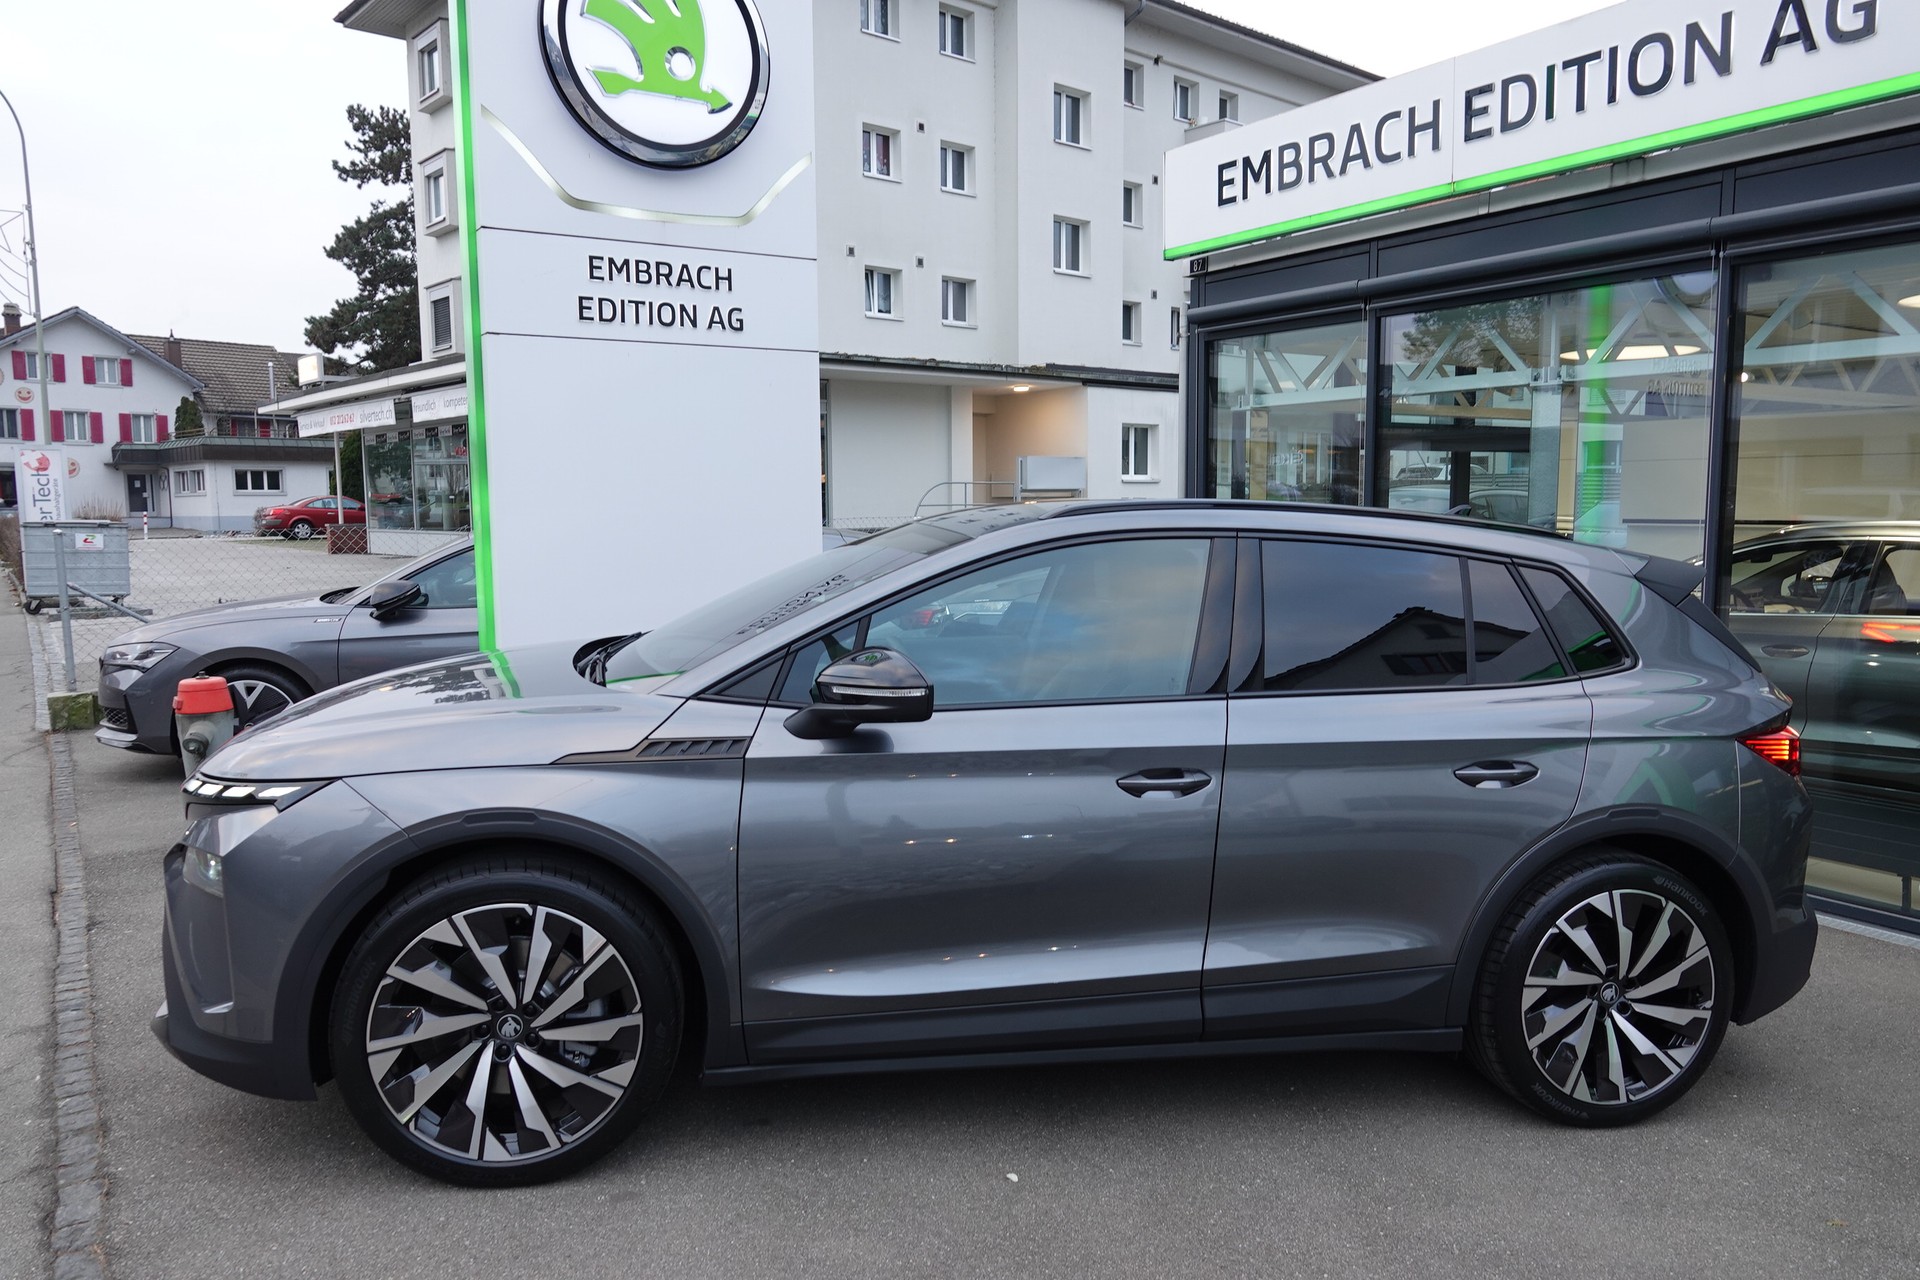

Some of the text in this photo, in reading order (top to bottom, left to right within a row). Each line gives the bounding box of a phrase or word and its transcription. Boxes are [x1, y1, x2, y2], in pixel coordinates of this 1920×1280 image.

[1217, 0, 1879, 208] EMBRACH EDITION AG
[588, 254, 733, 292] EMBRACH
[1193, 259, 1203, 272] 87
[577, 295, 745, 333] EDITION AG
[413, 398, 437, 413] freundlich
